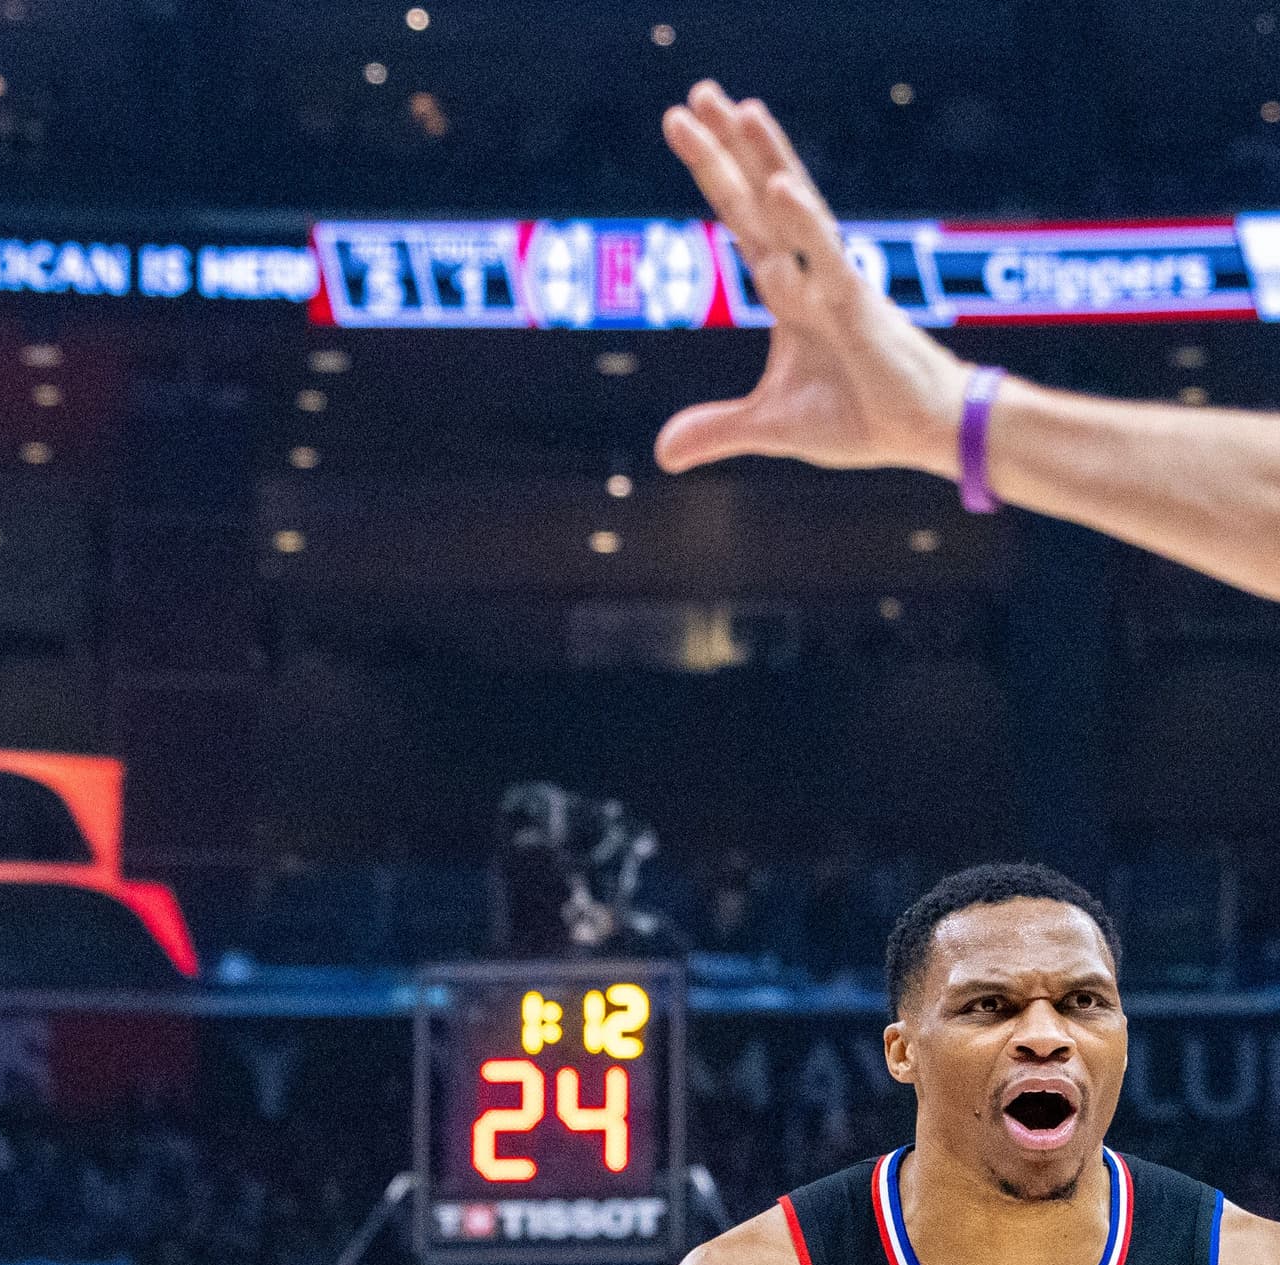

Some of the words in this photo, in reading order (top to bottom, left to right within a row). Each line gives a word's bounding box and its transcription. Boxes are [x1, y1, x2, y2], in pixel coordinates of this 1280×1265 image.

[138, 243, 192, 298] IS
[982, 246, 1215, 308] Clippers
[521, 983, 651, 1059] 1:12
[472, 1058, 630, 1183] 24
[499, 1199, 665, 1239] TISSOT
